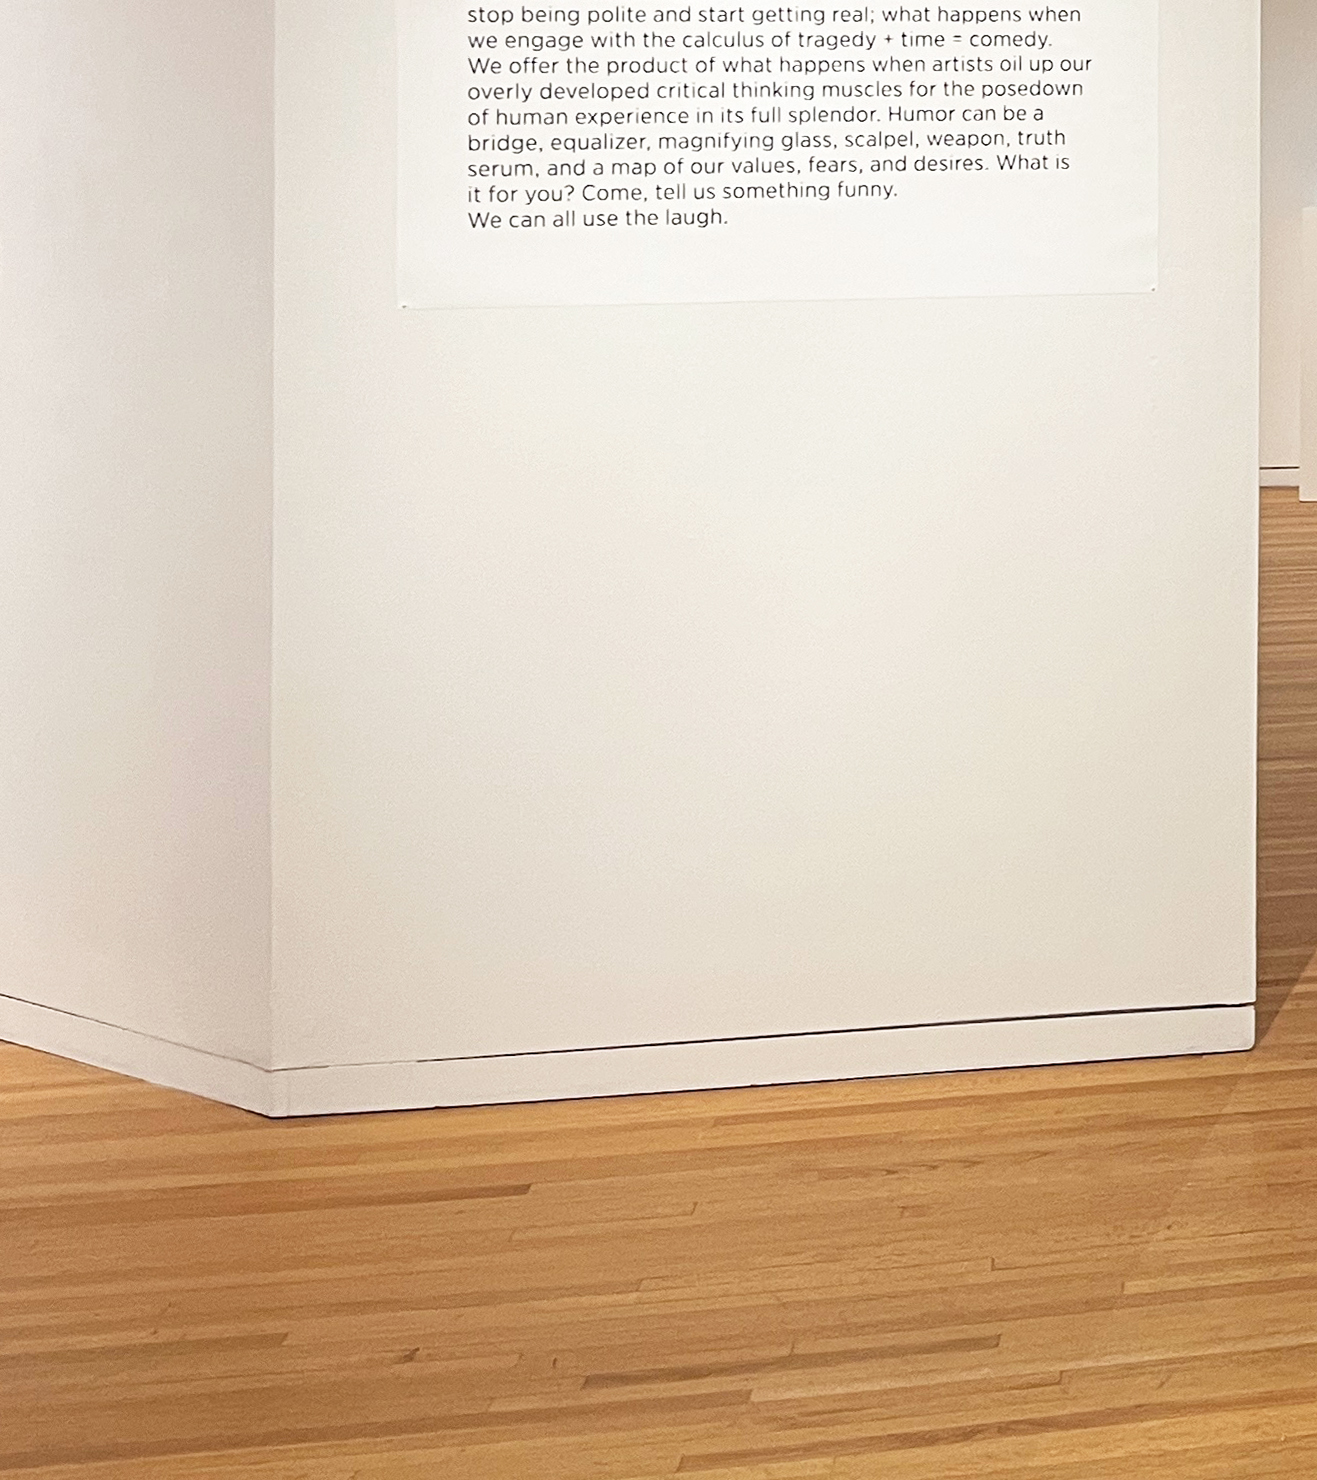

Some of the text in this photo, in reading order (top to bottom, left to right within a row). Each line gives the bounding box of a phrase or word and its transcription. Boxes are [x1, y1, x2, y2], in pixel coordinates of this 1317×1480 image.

[467, 5, 1081, 27] stop being polite and start getting real; what happens when
[467, 54, 1093, 77] We offer the product of what happens when artists oil up our
[467, 79, 1083, 104] overly developed critical thinking muscles for the posedown
[467, 128, 1066, 155] bridge, equalizer, magnifying glass, scalpel, weapon, truth
[467, 152, 1070, 179] serum, and a map of our values, fears, and desires. What is
[468, 180, 898, 206] it for you? Come, tell us something funny.
[467, 207, 728, 229] We can all use the laugh.
